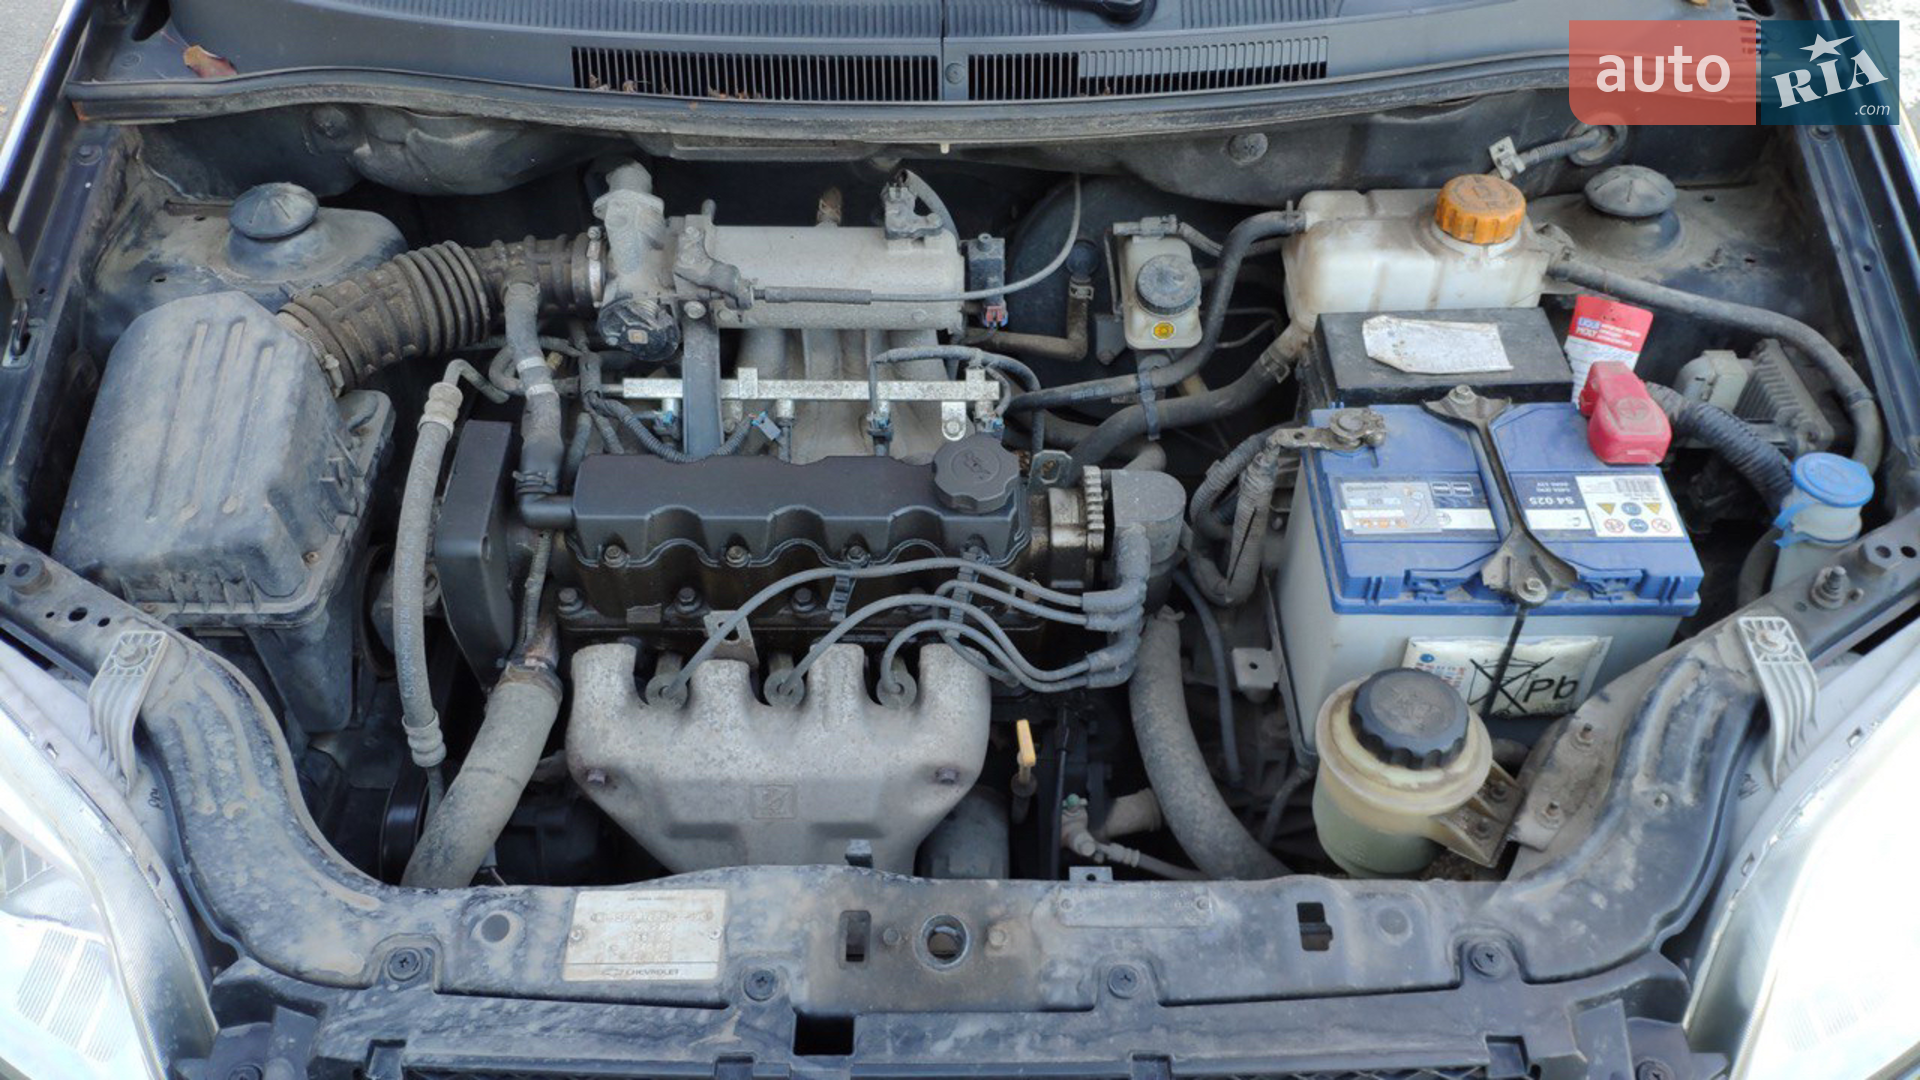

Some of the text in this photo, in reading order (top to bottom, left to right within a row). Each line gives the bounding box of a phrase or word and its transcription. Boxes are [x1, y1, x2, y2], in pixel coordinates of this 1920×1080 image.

[1528, 496, 1575, 505] S4 025
[1523, 675, 1581, 703] Pb
[625, 968, 679, 976] CHEVROLET
